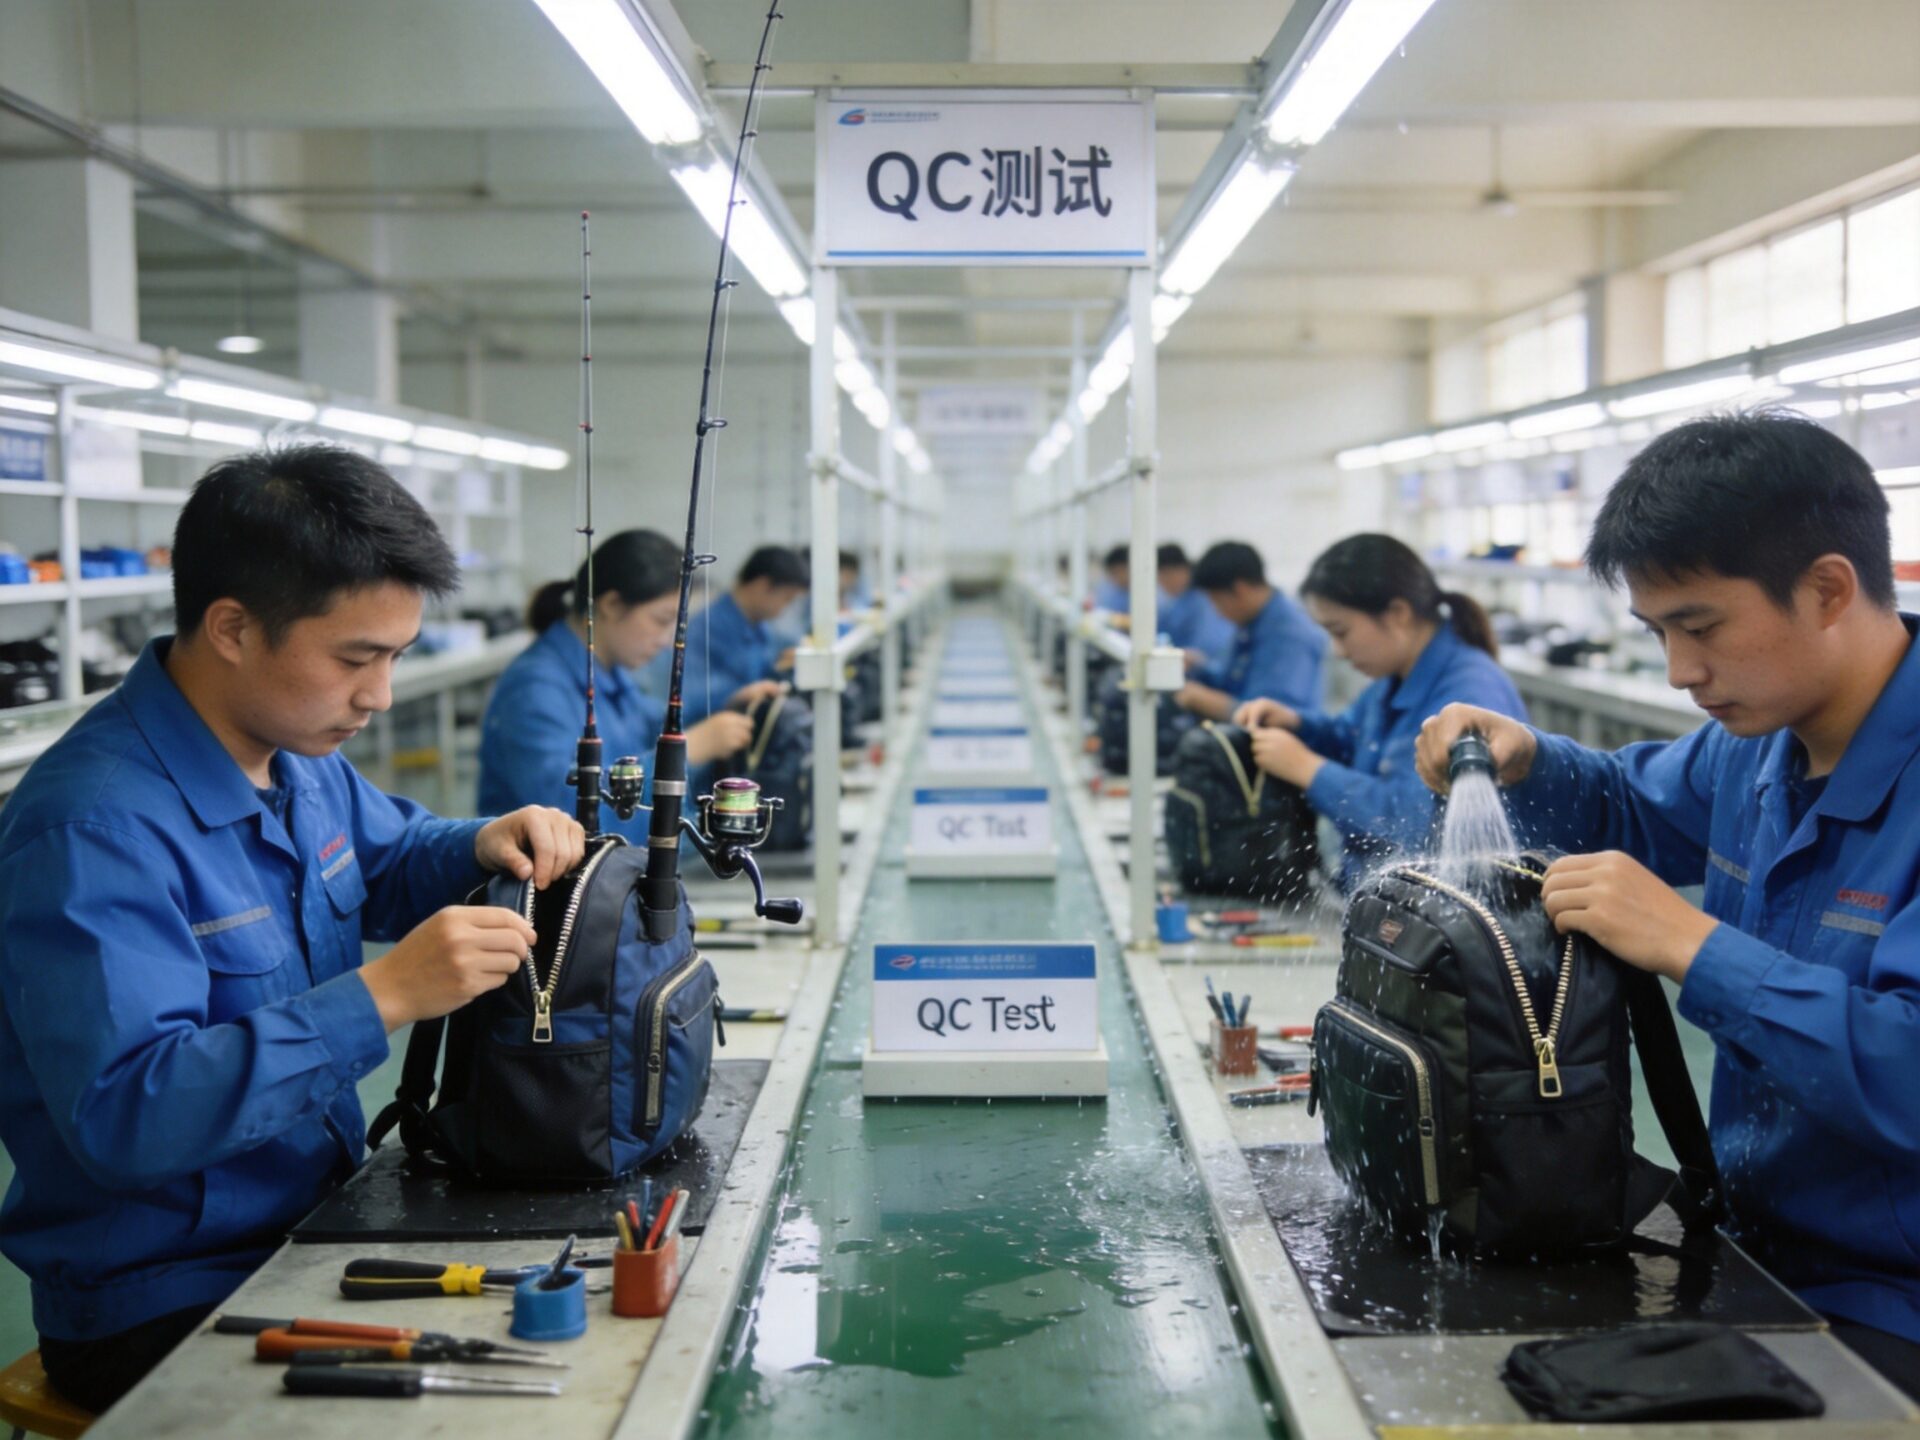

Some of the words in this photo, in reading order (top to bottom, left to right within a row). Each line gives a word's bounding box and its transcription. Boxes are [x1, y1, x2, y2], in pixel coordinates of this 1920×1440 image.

[867, 145, 1113, 221] QC测试
[938, 815, 973, 841] QC
[917, 997, 972, 1037] QC
[982, 995, 1056, 1033] Test
